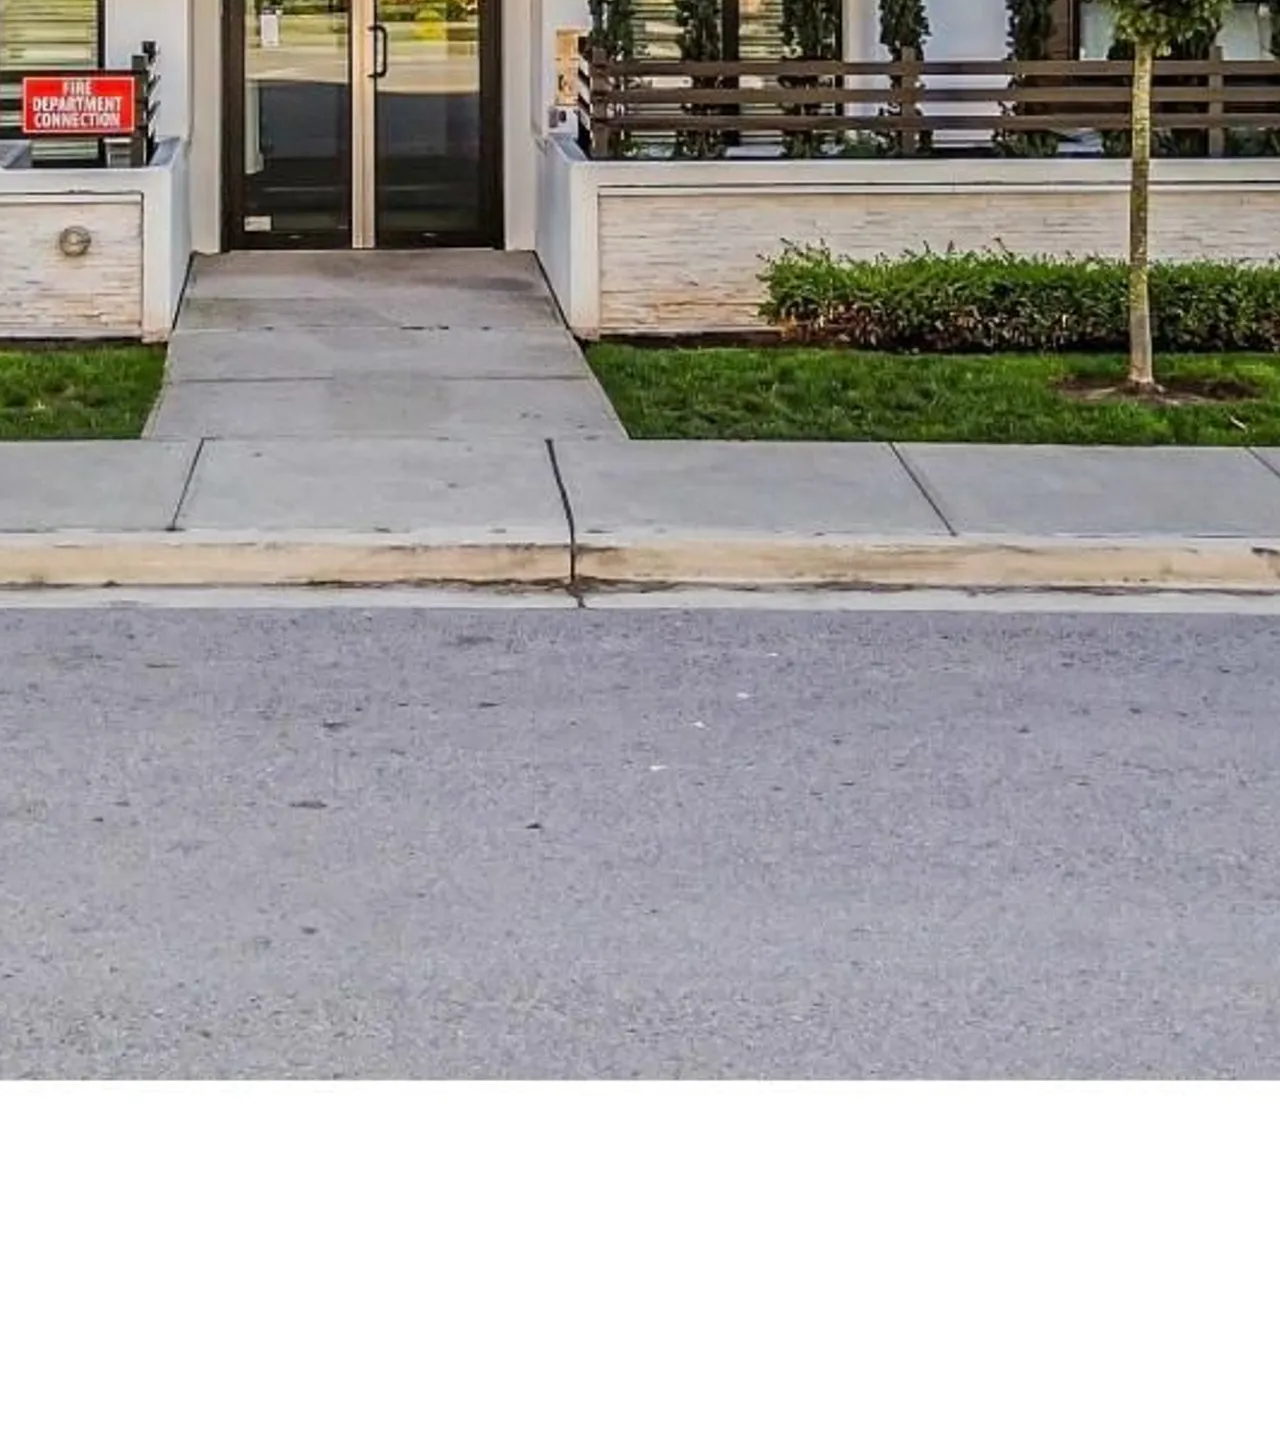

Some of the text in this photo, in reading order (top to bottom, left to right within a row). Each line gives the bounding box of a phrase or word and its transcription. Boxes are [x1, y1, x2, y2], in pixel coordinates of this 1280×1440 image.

[63, 80, 92, 96] FIRE
[32, 96, 122, 112] DEPARTMENT
[34, 113, 121, 128] CONNECTION
